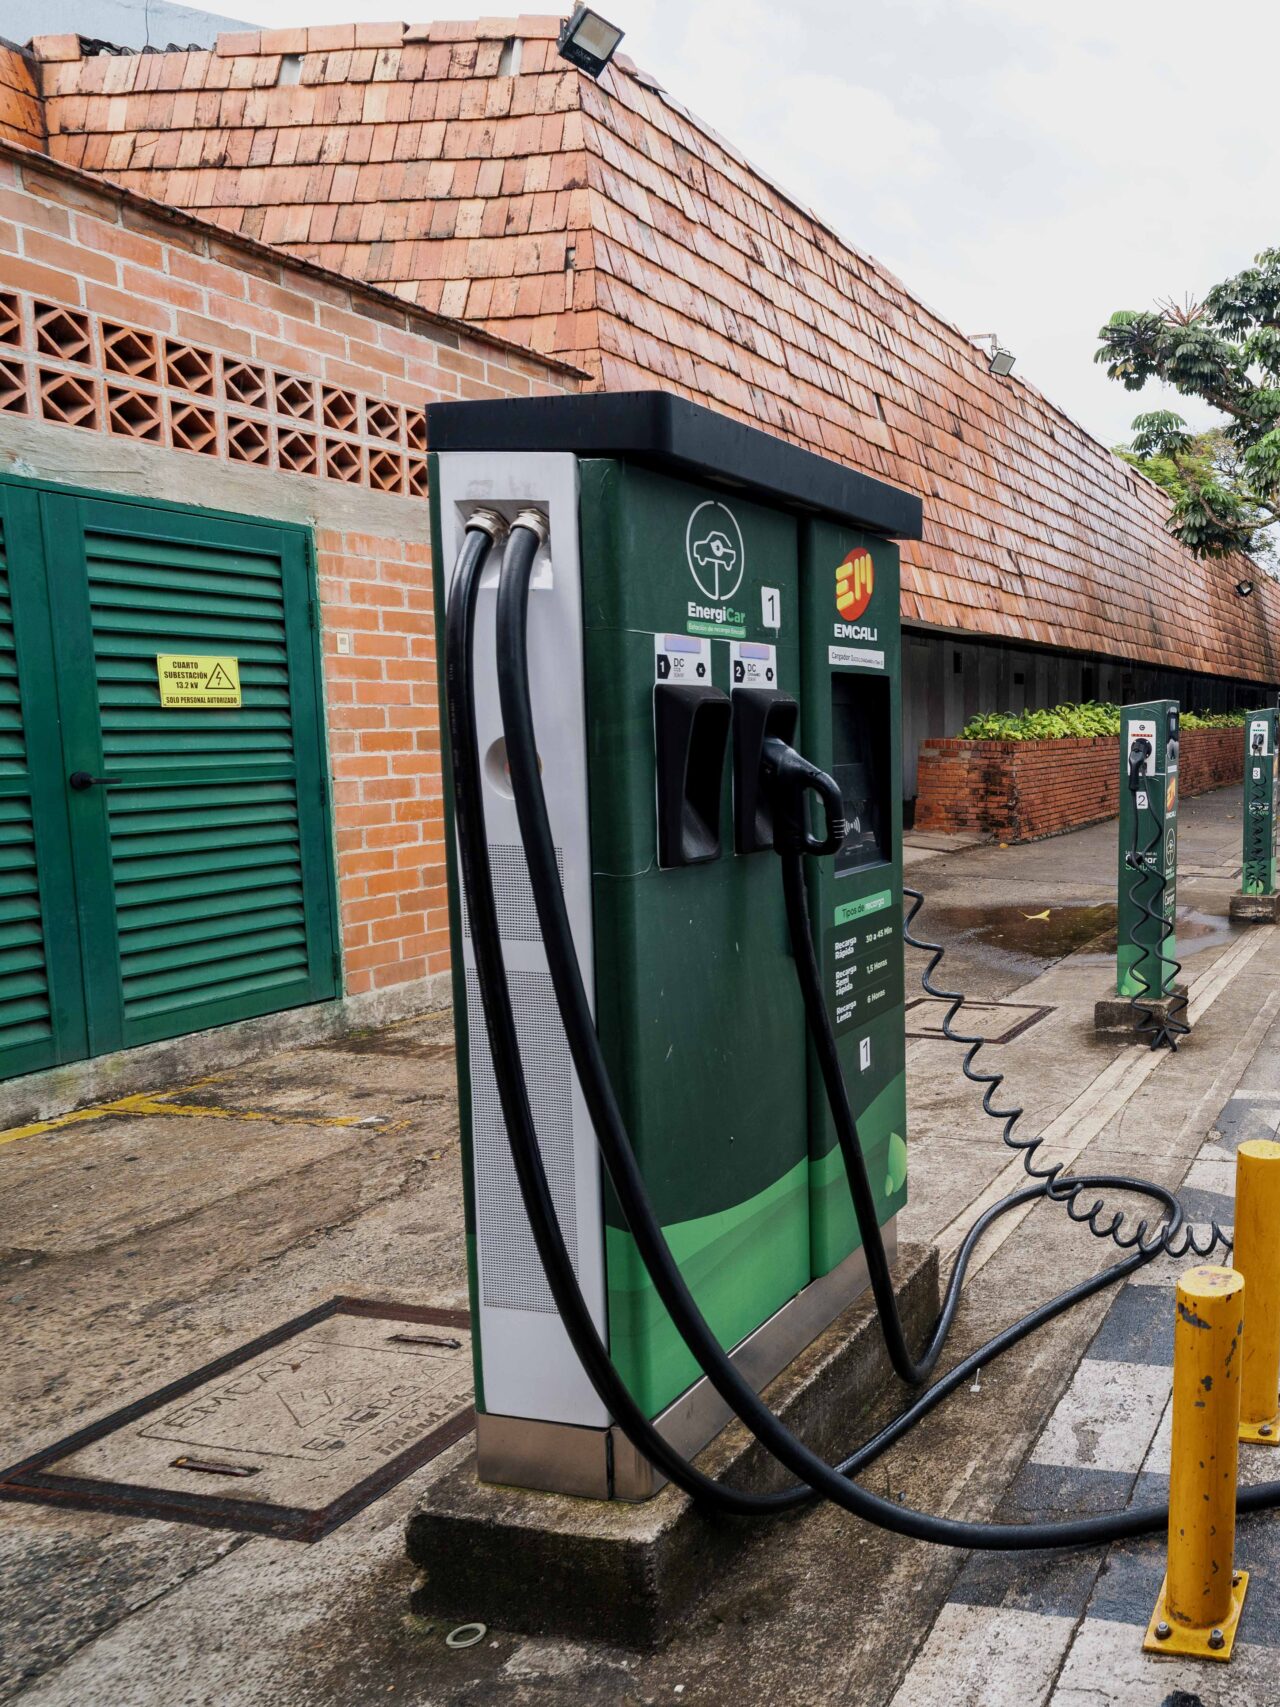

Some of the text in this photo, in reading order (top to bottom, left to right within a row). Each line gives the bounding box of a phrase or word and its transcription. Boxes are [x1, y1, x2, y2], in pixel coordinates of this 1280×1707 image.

[688, 601, 746, 624] EnergiCar
[768, 594, 775, 621] 1
[834, 623, 877, 641] EMCALI
[172, 661, 198, 669] CUARTO
[660, 660, 665, 673] 1
[673, 658, 685, 667] DC
[736, 666, 742, 677] 2
[747, 663, 757, 672] DC
[164, 671, 208, 679] SUBESTACIÓN
[180, 696, 206, 704] PERSONAL
[207, 696, 238, 704] AUTORIZADO
[1138, 795, 1146, 806] 2
[842, 906, 857, 919] Tipos
[858, 903, 865, 912] de
[834, 936, 857, 951] Recarga
[866, 933, 873, 943] 30
[877, 929, 884, 938] 45
[835, 965, 857, 980] Recarga
[874, 959, 888, 970] Horas
[835, 974, 850, 988] Semi
[836, 989, 886, 1015] Recarga 6 Horas
[836, 1011, 852, 1023] Lenta
[863, 1040, 868, 1062] 1
